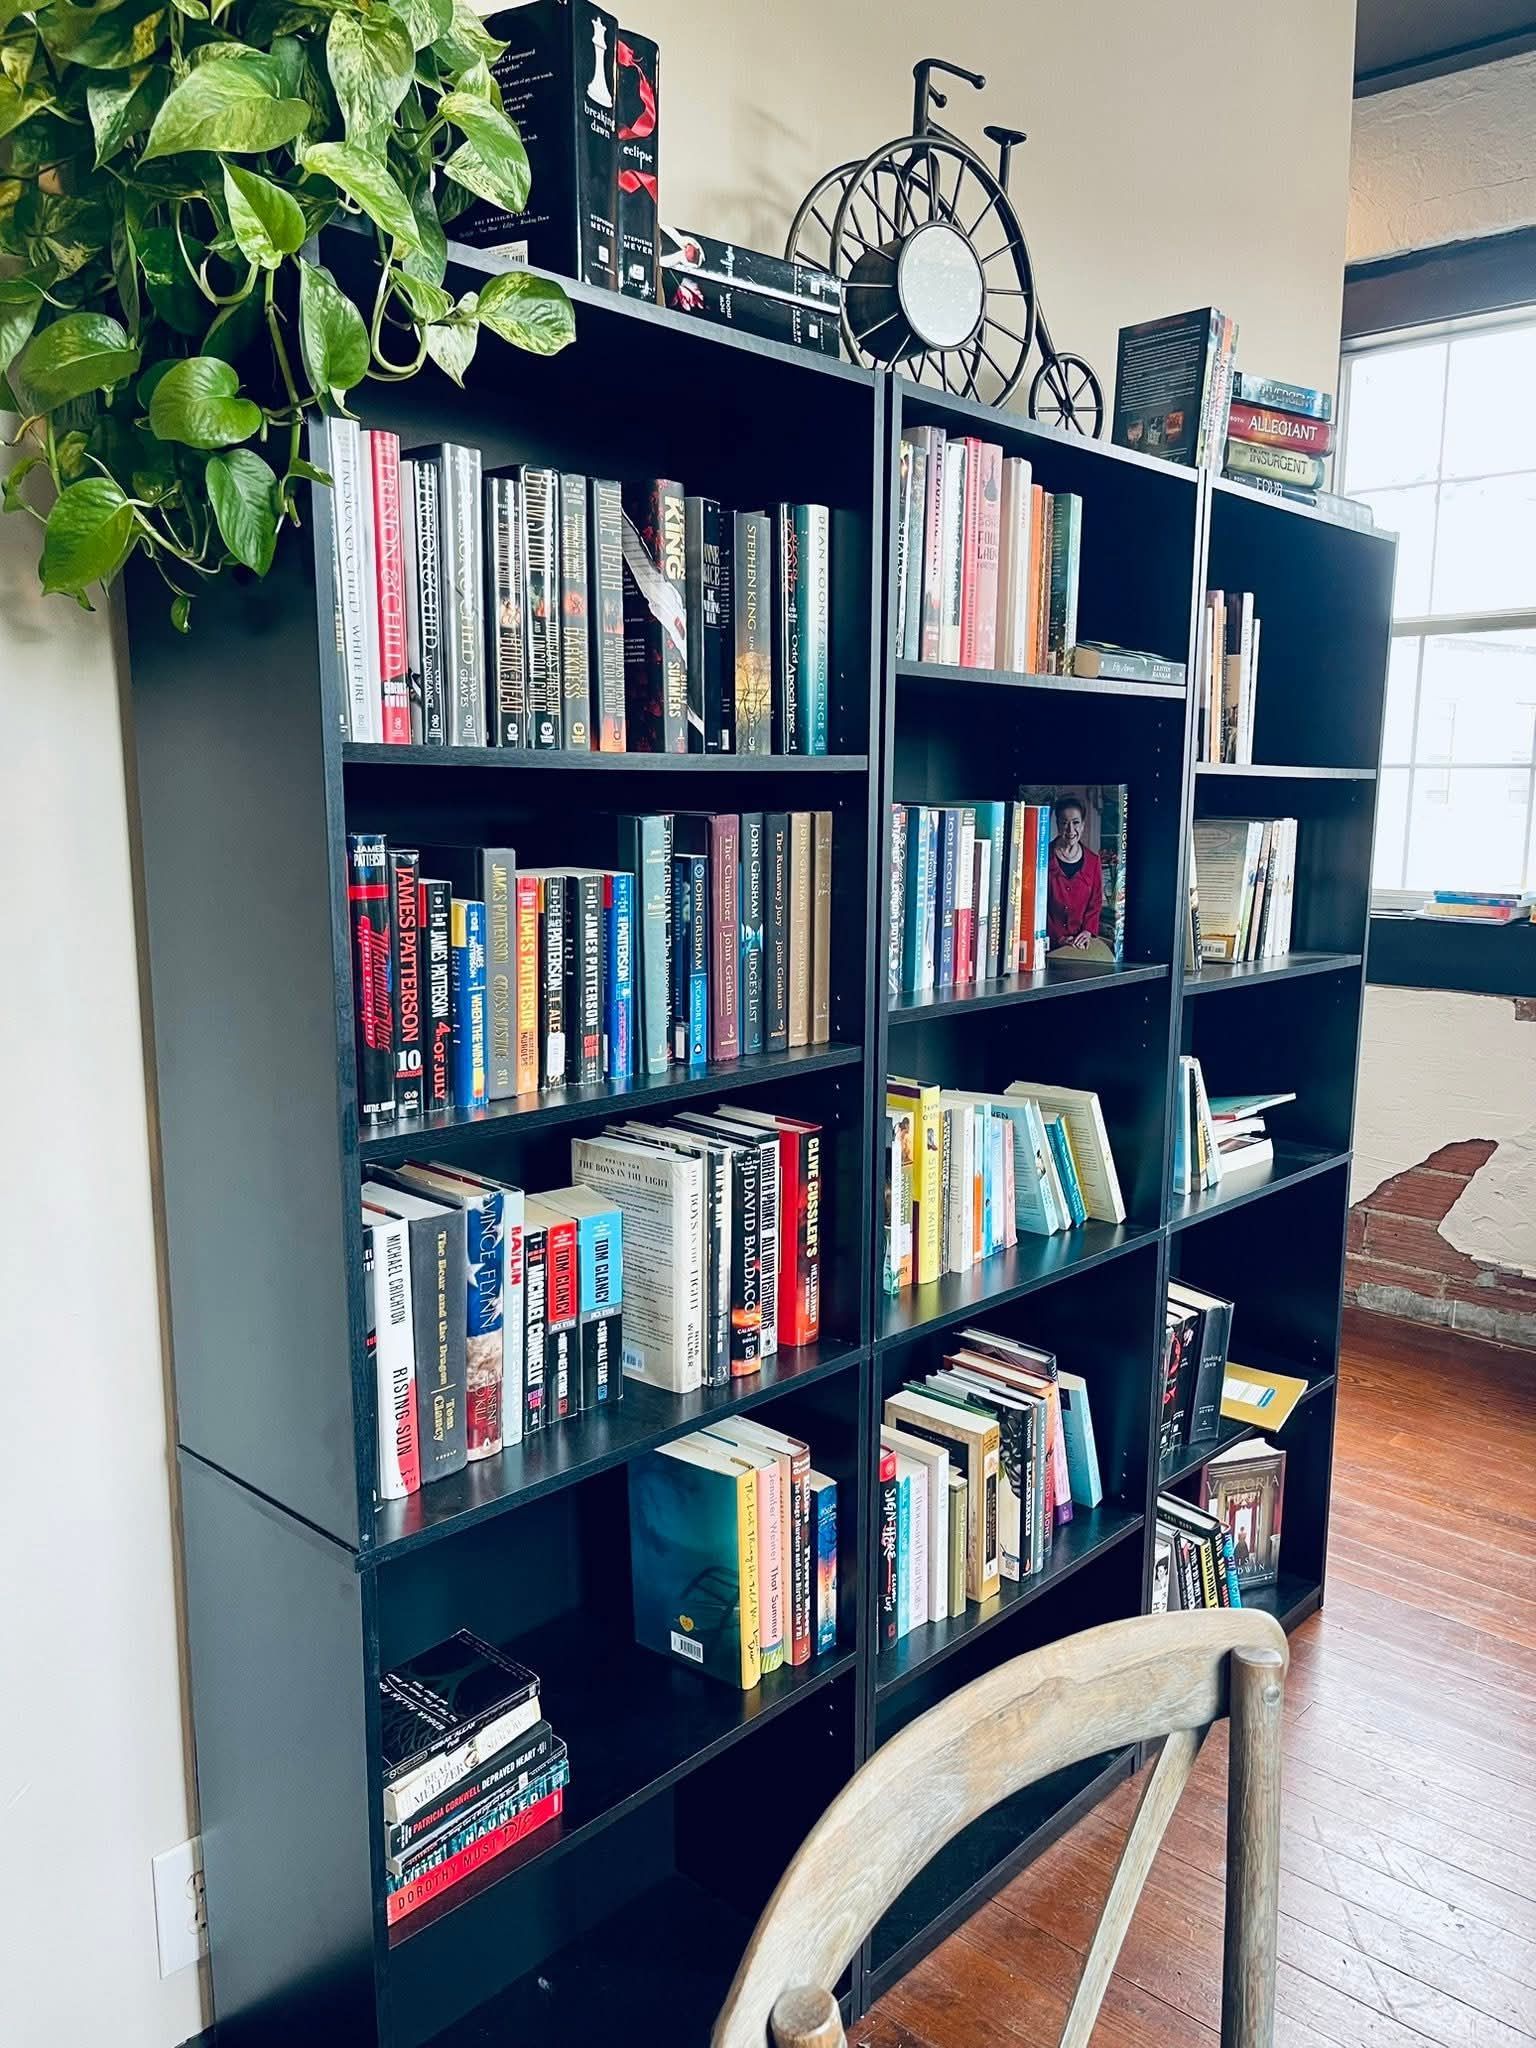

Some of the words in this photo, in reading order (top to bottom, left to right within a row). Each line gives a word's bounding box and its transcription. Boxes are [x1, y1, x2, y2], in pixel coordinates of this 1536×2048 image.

[583, 101, 616, 132] breaking
[590, 120, 610, 139] dawn
[623, 145, 653, 170] eclipse
[590, 220, 615, 238] MEYER
[623, 240, 653, 256] MEYER
[1261, 382, 1317, 408] DIVERGENT
[1248, 416, 1318, 441] ALLEGIANT
[1249, 447, 1308, 475] INSURGENT
[1255, 477, 1283, 497] FOUR
[380, 461, 398, 564] PRESTON
[600, 487, 621, 538] DANCE
[665, 495, 681, 580] KING
[747, 524, 757, 588] STEPHEN
[817, 516, 826, 560] DEAN
[499, 569, 511, 589] CHILD
[602, 544, 623, 591] DEATH
[423, 585, 438, 650] CHILD
[747, 590, 757, 631] KING
[817, 567, 826, 636] KOONTZ
[352, 624, 362, 671] WHITE
[381, 591, 402, 670] CHILD
[459, 597, 474, 664] CHILD
[546, 622, 559, 668] DOUGLAS
[790, 634, 799, 664] Odd
[500, 636, 523, 672] BOOK
[529, 634, 547, 679] LINCOLN
[563, 626, 580, 698] DARKNESS
[604, 647, 617, 684] LINCOLN
[354, 675, 365, 706] FIRE
[424, 653, 435, 708] VENGEANCE
[459, 667, 469, 708] GRAVES
[469, 674, 478, 701] TWO
[500, 680, 523, 714] DEAD
[529, 681, 547, 712] CHILD
[546, 669, 561, 716] PRESTON
[604, 685, 617, 713] CHILD
[667, 662, 681, 718] SUMMERS
[786, 663, 798, 734] Apocalypse
[816, 641, 825, 730] INNOCENCE
[724, 834, 734, 867] The
[749, 823, 762, 858] JOHN
[775, 831, 784, 853] The
[891, 813, 901, 864] UNTAMED
[945, 815, 955, 846] JODI
[353, 854, 386, 868] PATTERSON
[775, 855, 784, 904] Runaway
[945, 850, 955, 907] PICOULT
[395, 866, 418, 929] JAMES
[491, 864, 507, 903] JAMES
[695, 879, 704, 912] JOHN
[723, 869, 733, 922] Chamber
[750, 860, 762, 919] GRISHAM
[520, 908, 534, 953] JAMES
[585, 913, 599, 955] JAMES
[774, 904, 784, 928] Jury
[430, 929, 449, 962] JAMES
[547, 928, 562, 991] PATTERSON
[616, 922, 630, 982] PATTERSON
[695, 915, 704, 970] GRISHAM
[722, 931, 733, 961] John
[775, 940, 784, 965] John
[398, 931, 419, 1042] PATTERSON
[430, 963, 449, 1017] PATTERSON
[520, 955, 535, 1031] PATTERSON
[585, 957, 599, 1027] PATTERSON
[694, 979, 703, 1021] SYCAMORE
[725, 964, 736, 1016] Grisham
[776, 966, 785, 1010] Grisham
[471, 993, 484, 1022] WHEN
[749, 998, 760, 1024] LIST
[434, 1041, 445, 1063] OF
[471, 1022, 484, 1043] THE
[694, 1023, 703, 1043] ROW
[397, 1049, 422, 1072] 10
[433, 1064, 446, 1098] JULY
[579, 1159, 592, 1170] THE
[595, 1163, 615, 1176] BOYS
[615, 1167, 625, 1178] IN
[627, 1171, 641, 1181] THE
[645, 1175, 669, 1189] LIGHT
[761, 1147, 775, 1184] ROBERT
[807, 1137, 820, 1180] CLIVE
[928, 1157, 937, 1205] SISTER
[690, 1192, 699, 1230] BOYS
[743, 1178, 756, 1232] DAVID
[761, 1192, 776, 1231] PARKER
[806, 1181, 820, 1257] CUSSLER'S
[437, 1231, 447, 1256] The
[479, 1200, 497, 1265] VINCE
[761, 1237, 776, 1254] ALL
[927, 1210, 937, 1248] MINE
[386, 1233, 403, 1277] MICHAEL
[510, 1226, 522, 1285] RAYLAN
[555, 1248, 570, 1273] TOM
[595, 1238, 609, 1262] TOM
[761, 1254, 776, 1275] OUR
[437, 1259, 447, 1290] Bear
[527, 1262, 545, 1323] MICHAEL
[595, 1264, 609, 1304] CLANCY
[809, 1263, 818, 1324] HELLBURNER
[388, 1280, 406, 1326] CRICHTON
[437, 1293, 447, 1318] and
[479, 1268, 497, 1328] FLYNN
[555, 1275, 570, 1316] CLANCY
[760, 1275, 776, 1330] YESTERDAYS
[437, 1321, 448, 1343] the
[437, 1344, 449, 1385] Dragon
[527, 1323, 545, 1387] CONNELLY
[392, 1366, 410, 1421] RISING
[474, 1399, 487, 1425] KILL
[433, 1396, 447, 1442] Clancy
[446, 1398, 456, 1431] Tom
[1026, 1416, 1034, 1449] Wooten
[395, 1424, 413, 1457] SUN
[744, 1482, 754, 1500] The
[769, 1473, 779, 1517] Jennifer
[882, 1488, 897, 1522] SIGN
[1025, 1461, 1033, 1536] BLACKBERRIES
[1206, 1474, 1280, 1497] VICTORIA
[769, 1521, 779, 1561] Weiner
[770, 1566, 779, 1591] That
[795, 1582, 803, 1601] Birth
[770, 1595, 780, 1639] Summer
[413, 1807, 445, 1834] PATRICIA
[445, 1784, 481, 1813] CORNWELL
[481, 1761, 515, 1790] DEPRAVED
[515, 1747, 537, 1769] HEART
[465, 1792, 539, 1846] HAUNTED
[398, 1863, 457, 1910] DOROTHY
[463, 1838, 497, 1867] MUST
[501, 1811, 537, 1849] DIE
